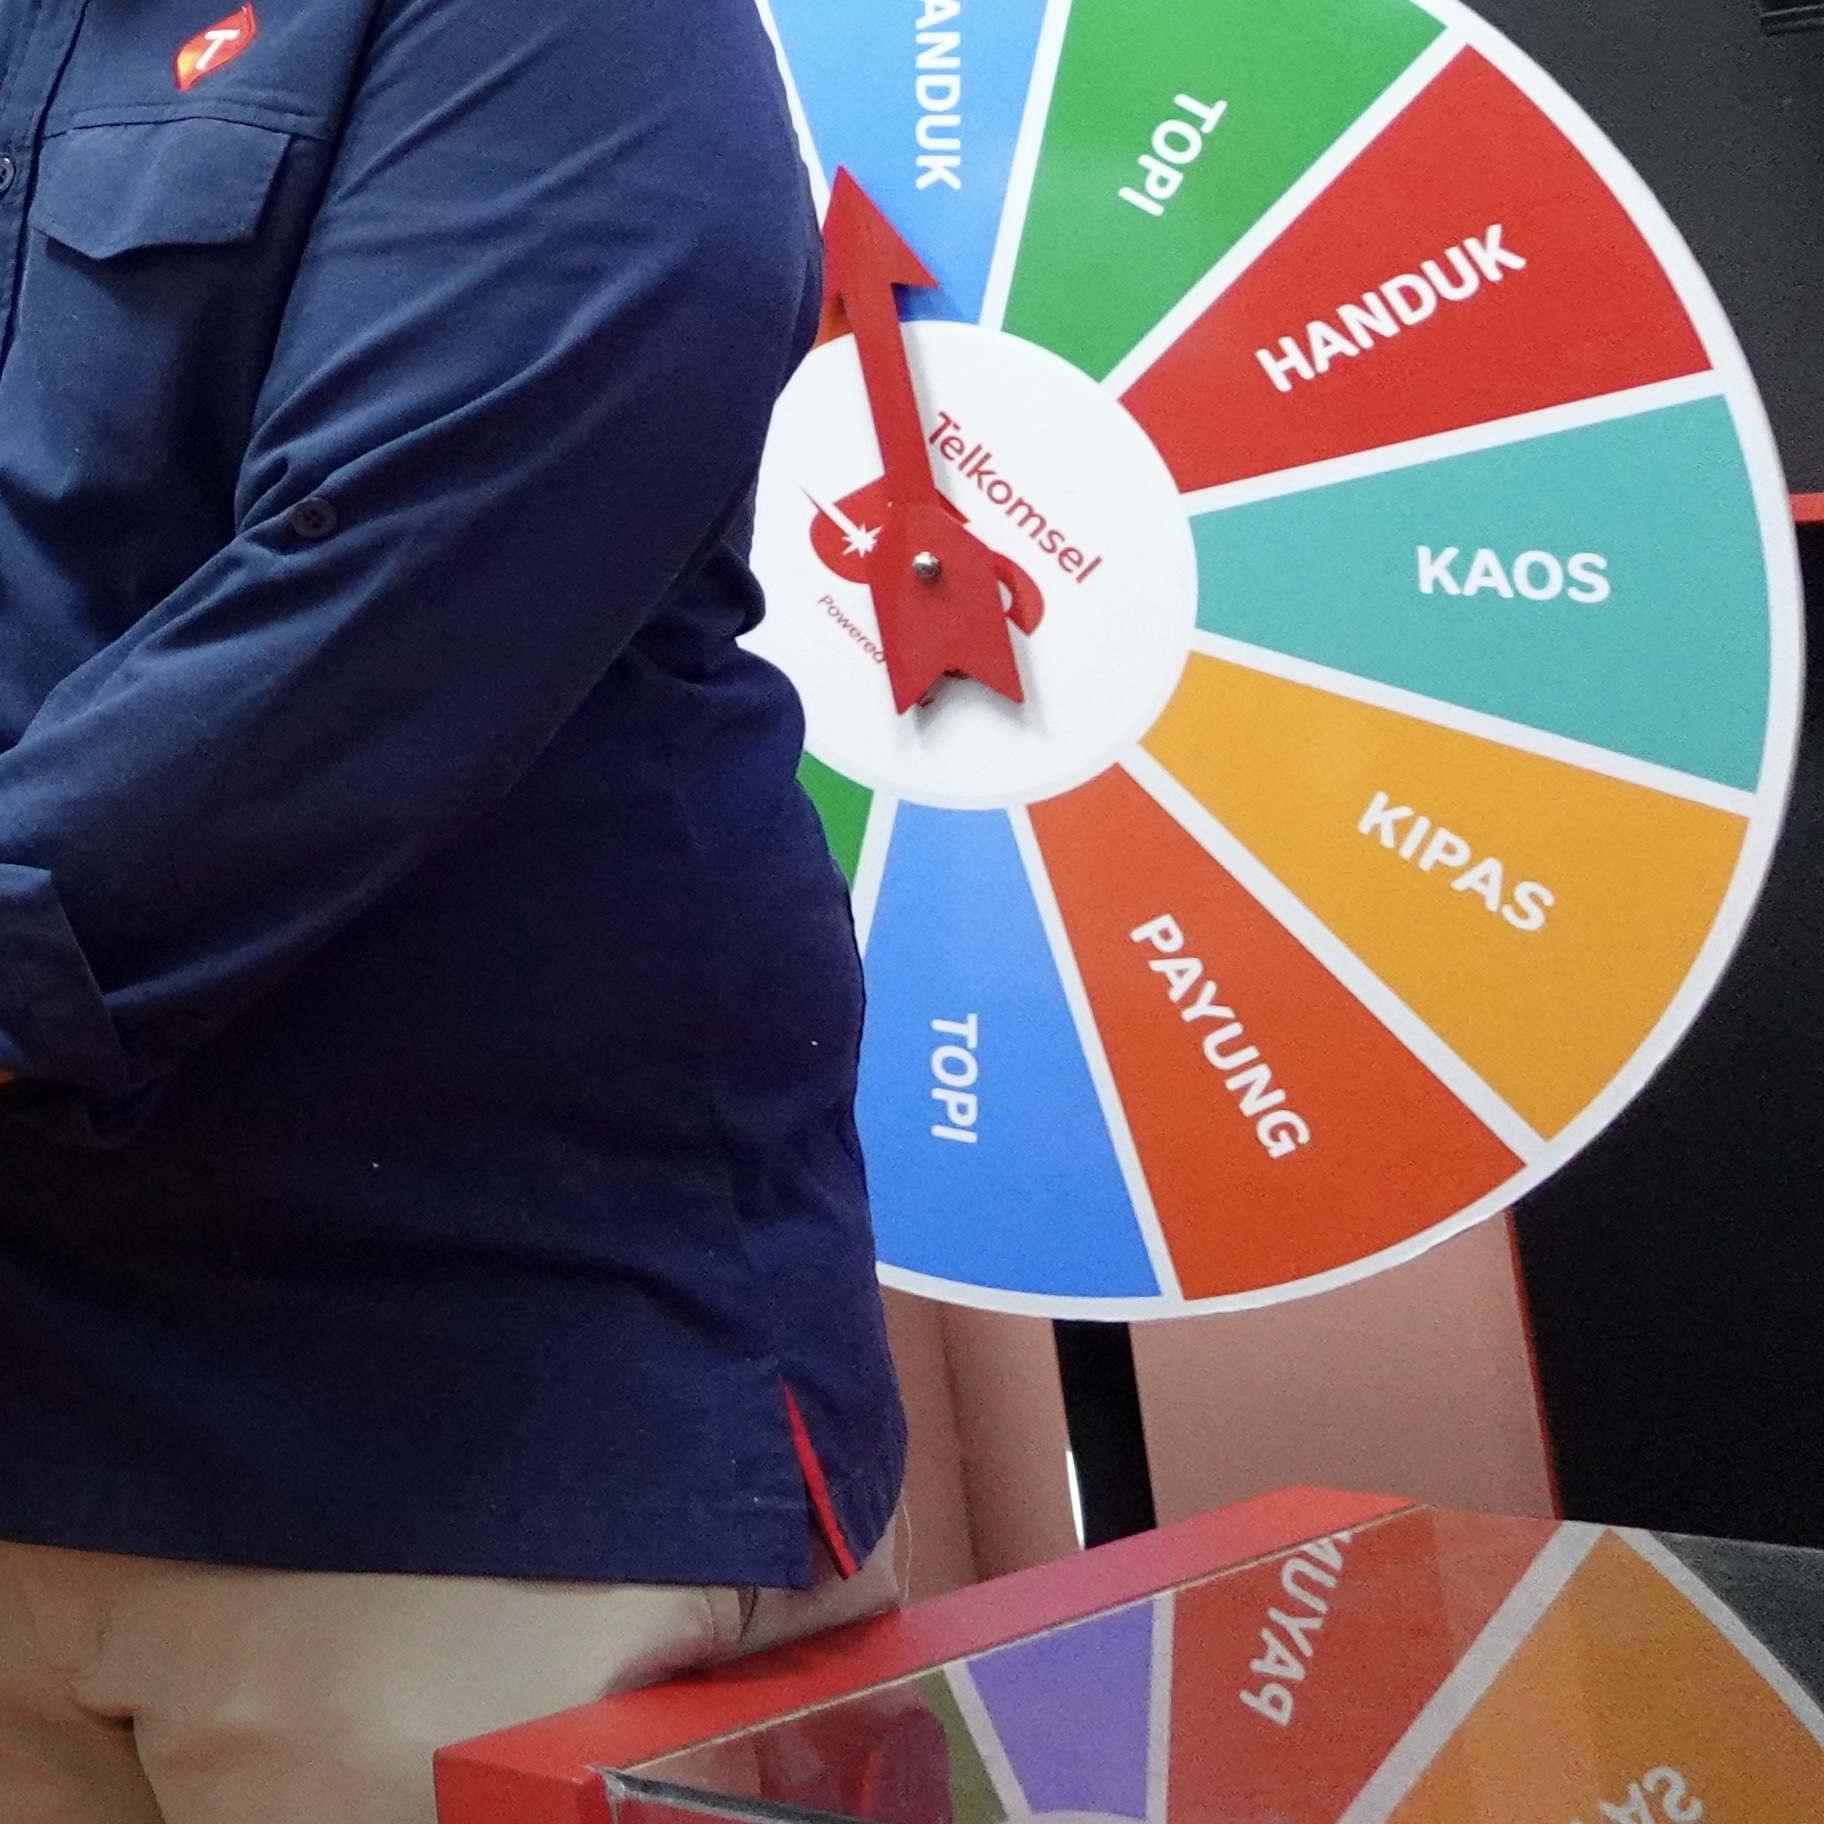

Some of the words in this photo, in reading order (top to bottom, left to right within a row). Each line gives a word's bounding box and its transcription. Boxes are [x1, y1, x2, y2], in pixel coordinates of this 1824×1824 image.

[1117, 93, 1228, 217] TOPI
[1254, 223, 1527, 393] HANDUK
[929, 411, 1103, 584] Telkomsel
[1416, 544, 1612, 604] KAOS
[1357, 790, 1556, 933] KIPAS
[930, 1012, 979, 1144] TOPI
[1130, 912, 1311, 1159] PAYUNG
